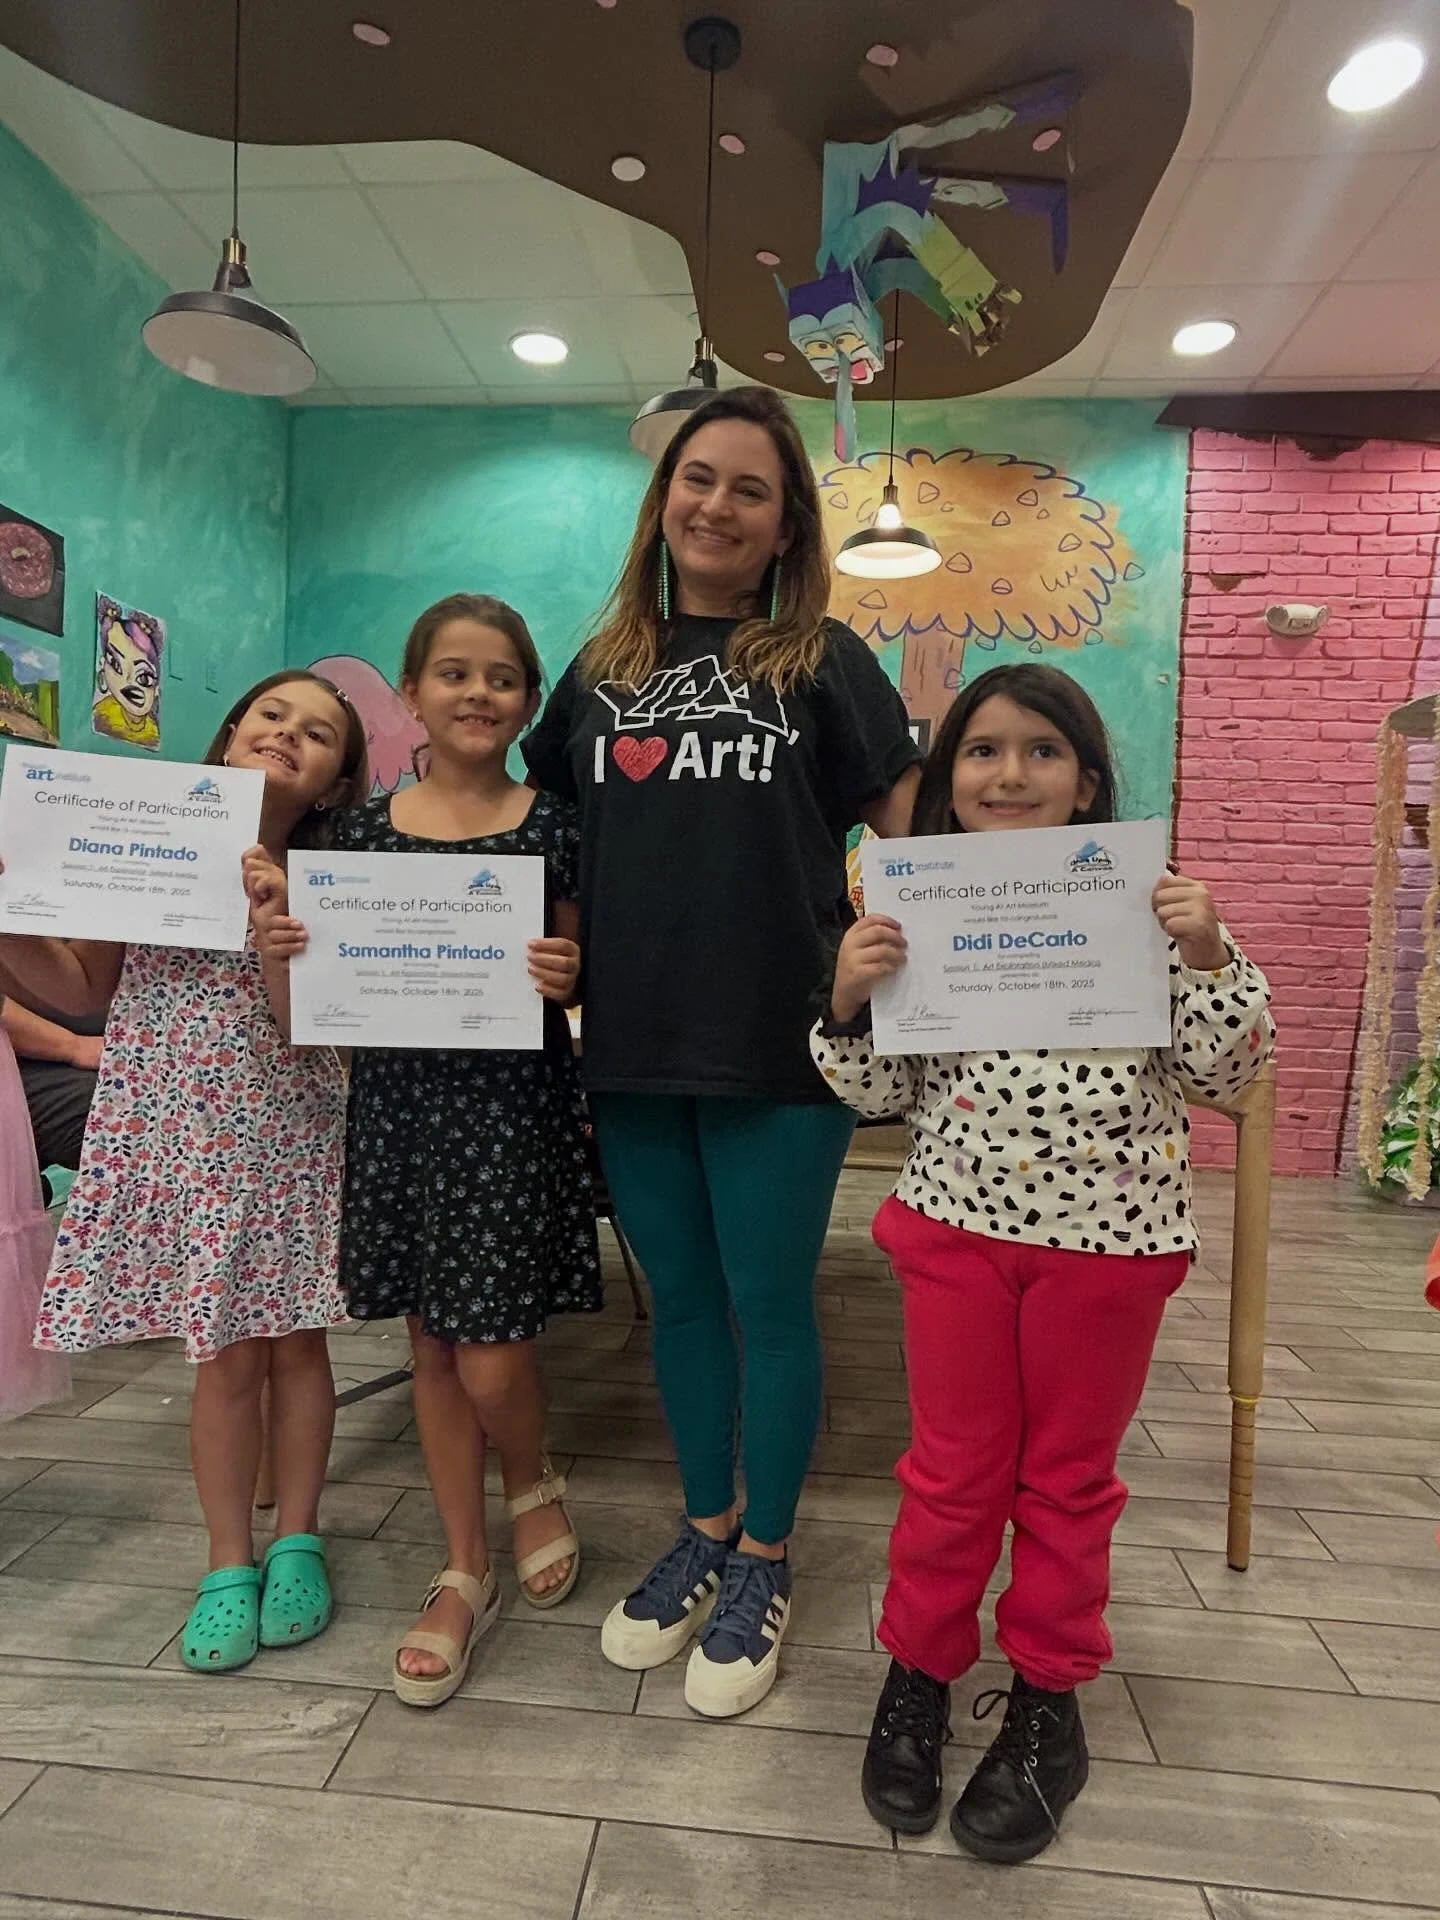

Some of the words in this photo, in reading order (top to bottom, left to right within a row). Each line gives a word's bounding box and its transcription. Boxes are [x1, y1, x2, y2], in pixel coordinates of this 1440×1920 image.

[594, 735, 606, 784] I
[668, 731, 777, 784] Art!
[26, 768, 54, 781] art
[35, 791, 115, 810] Certificate
[119, 800, 135, 812] of
[138, 800, 229, 820] Participation
[69, 837, 124, 856] Diana
[129, 842, 198, 861] Pintado
[885, 861, 915, 877] art
[309, 873, 336, 886] art
[898, 884, 985, 902] Certificate
[992, 881, 1009, 897] of
[1014, 876, 1126, 896] Participation
[319, 896, 397, 911] Certificate
[400, 899, 416, 911] of
[420, 899, 512, 915] Participation
[953, 933, 992, 951] Didi
[998, 930, 1088, 949] DeCarlo
[338, 942, 431, 959] Samantha
[437, 944, 505, 960] Pintado
[998, 981, 1041, 991] October
[1071, 979, 1095, 989] 2025
